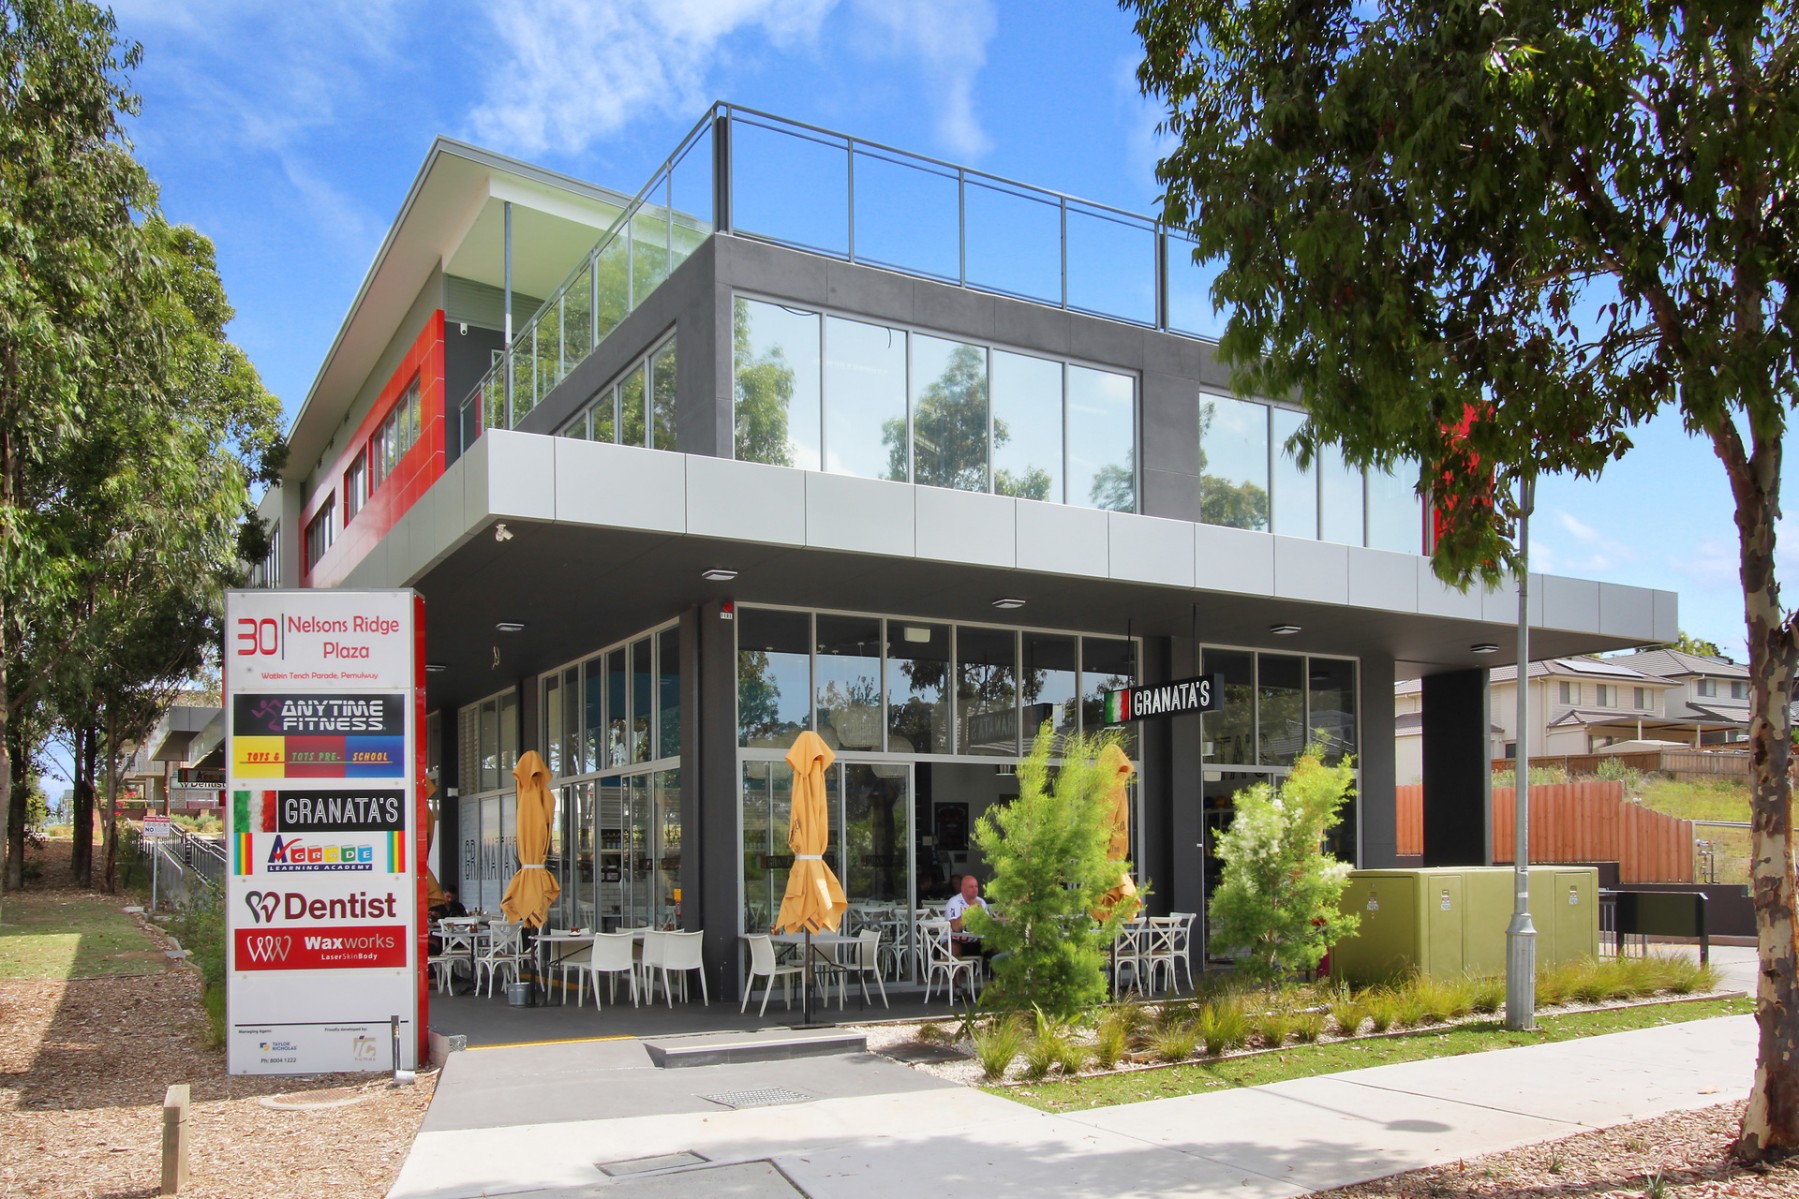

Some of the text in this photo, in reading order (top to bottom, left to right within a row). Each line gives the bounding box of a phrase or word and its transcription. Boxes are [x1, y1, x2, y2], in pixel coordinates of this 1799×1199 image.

[287, 615, 400, 635] Nelsons Ridge
[237, 618, 278, 656] 30
[323, 641, 370, 659] Plaza
[261, 672, 288, 680] Watkin
[311, 672, 339, 680] Parade,
[341, 672, 379, 680] Pemulwuy
[1134, 680, 1210, 716] GRANATA'S
[281, 700, 383, 716] ANYTIME
[283, 718, 384, 731] FITNESS
[247, 752, 270, 762] TOYS
[291, 752, 315, 761] TOTS
[318, 752, 341, 761] PRE-
[352, 752, 388, 761] SCHOOL
[285, 797, 399, 824] GRANATA'S
[284, 891, 397, 920] Dentist
[304, 933, 395, 950] Waxworks
[321, 952, 378, 961] LaserSkinBody
